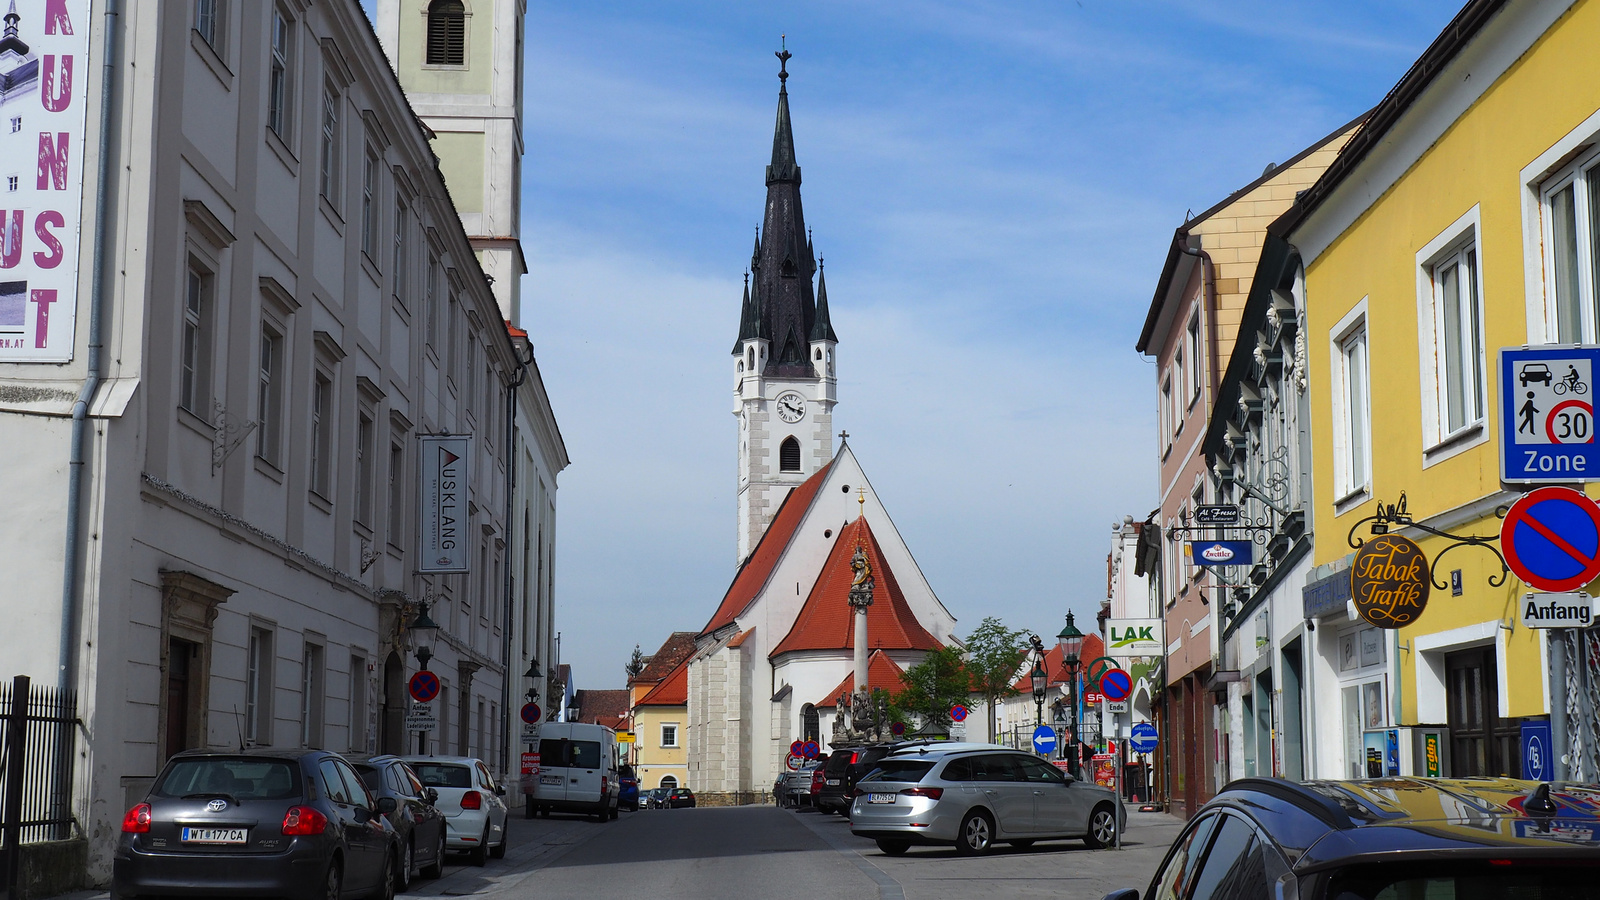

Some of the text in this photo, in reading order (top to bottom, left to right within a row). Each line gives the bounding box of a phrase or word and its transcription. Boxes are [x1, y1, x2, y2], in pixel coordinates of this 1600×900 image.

[1558, 412, 1587, 439] 30
[1523, 450, 1587, 472] Zone
[438, 445, 460, 550] AUSKLANG
[1198, 508, 1237, 518] Al Fresco
[1205, 550, 1231, 558] Zwettler
[1356, 550, 1424, 583] Tabak
[1452, 572, 1458, 586] 9
[1358, 581, 1424, 615] Trafik
[1524, 601, 1590, 623] Anfang
[1111, 626, 1155, 641] LAK
[412, 704, 432, 712] Anfang
[1109, 703, 1124, 711] Ende
[191, 829, 243, 840] WT 177 CA
